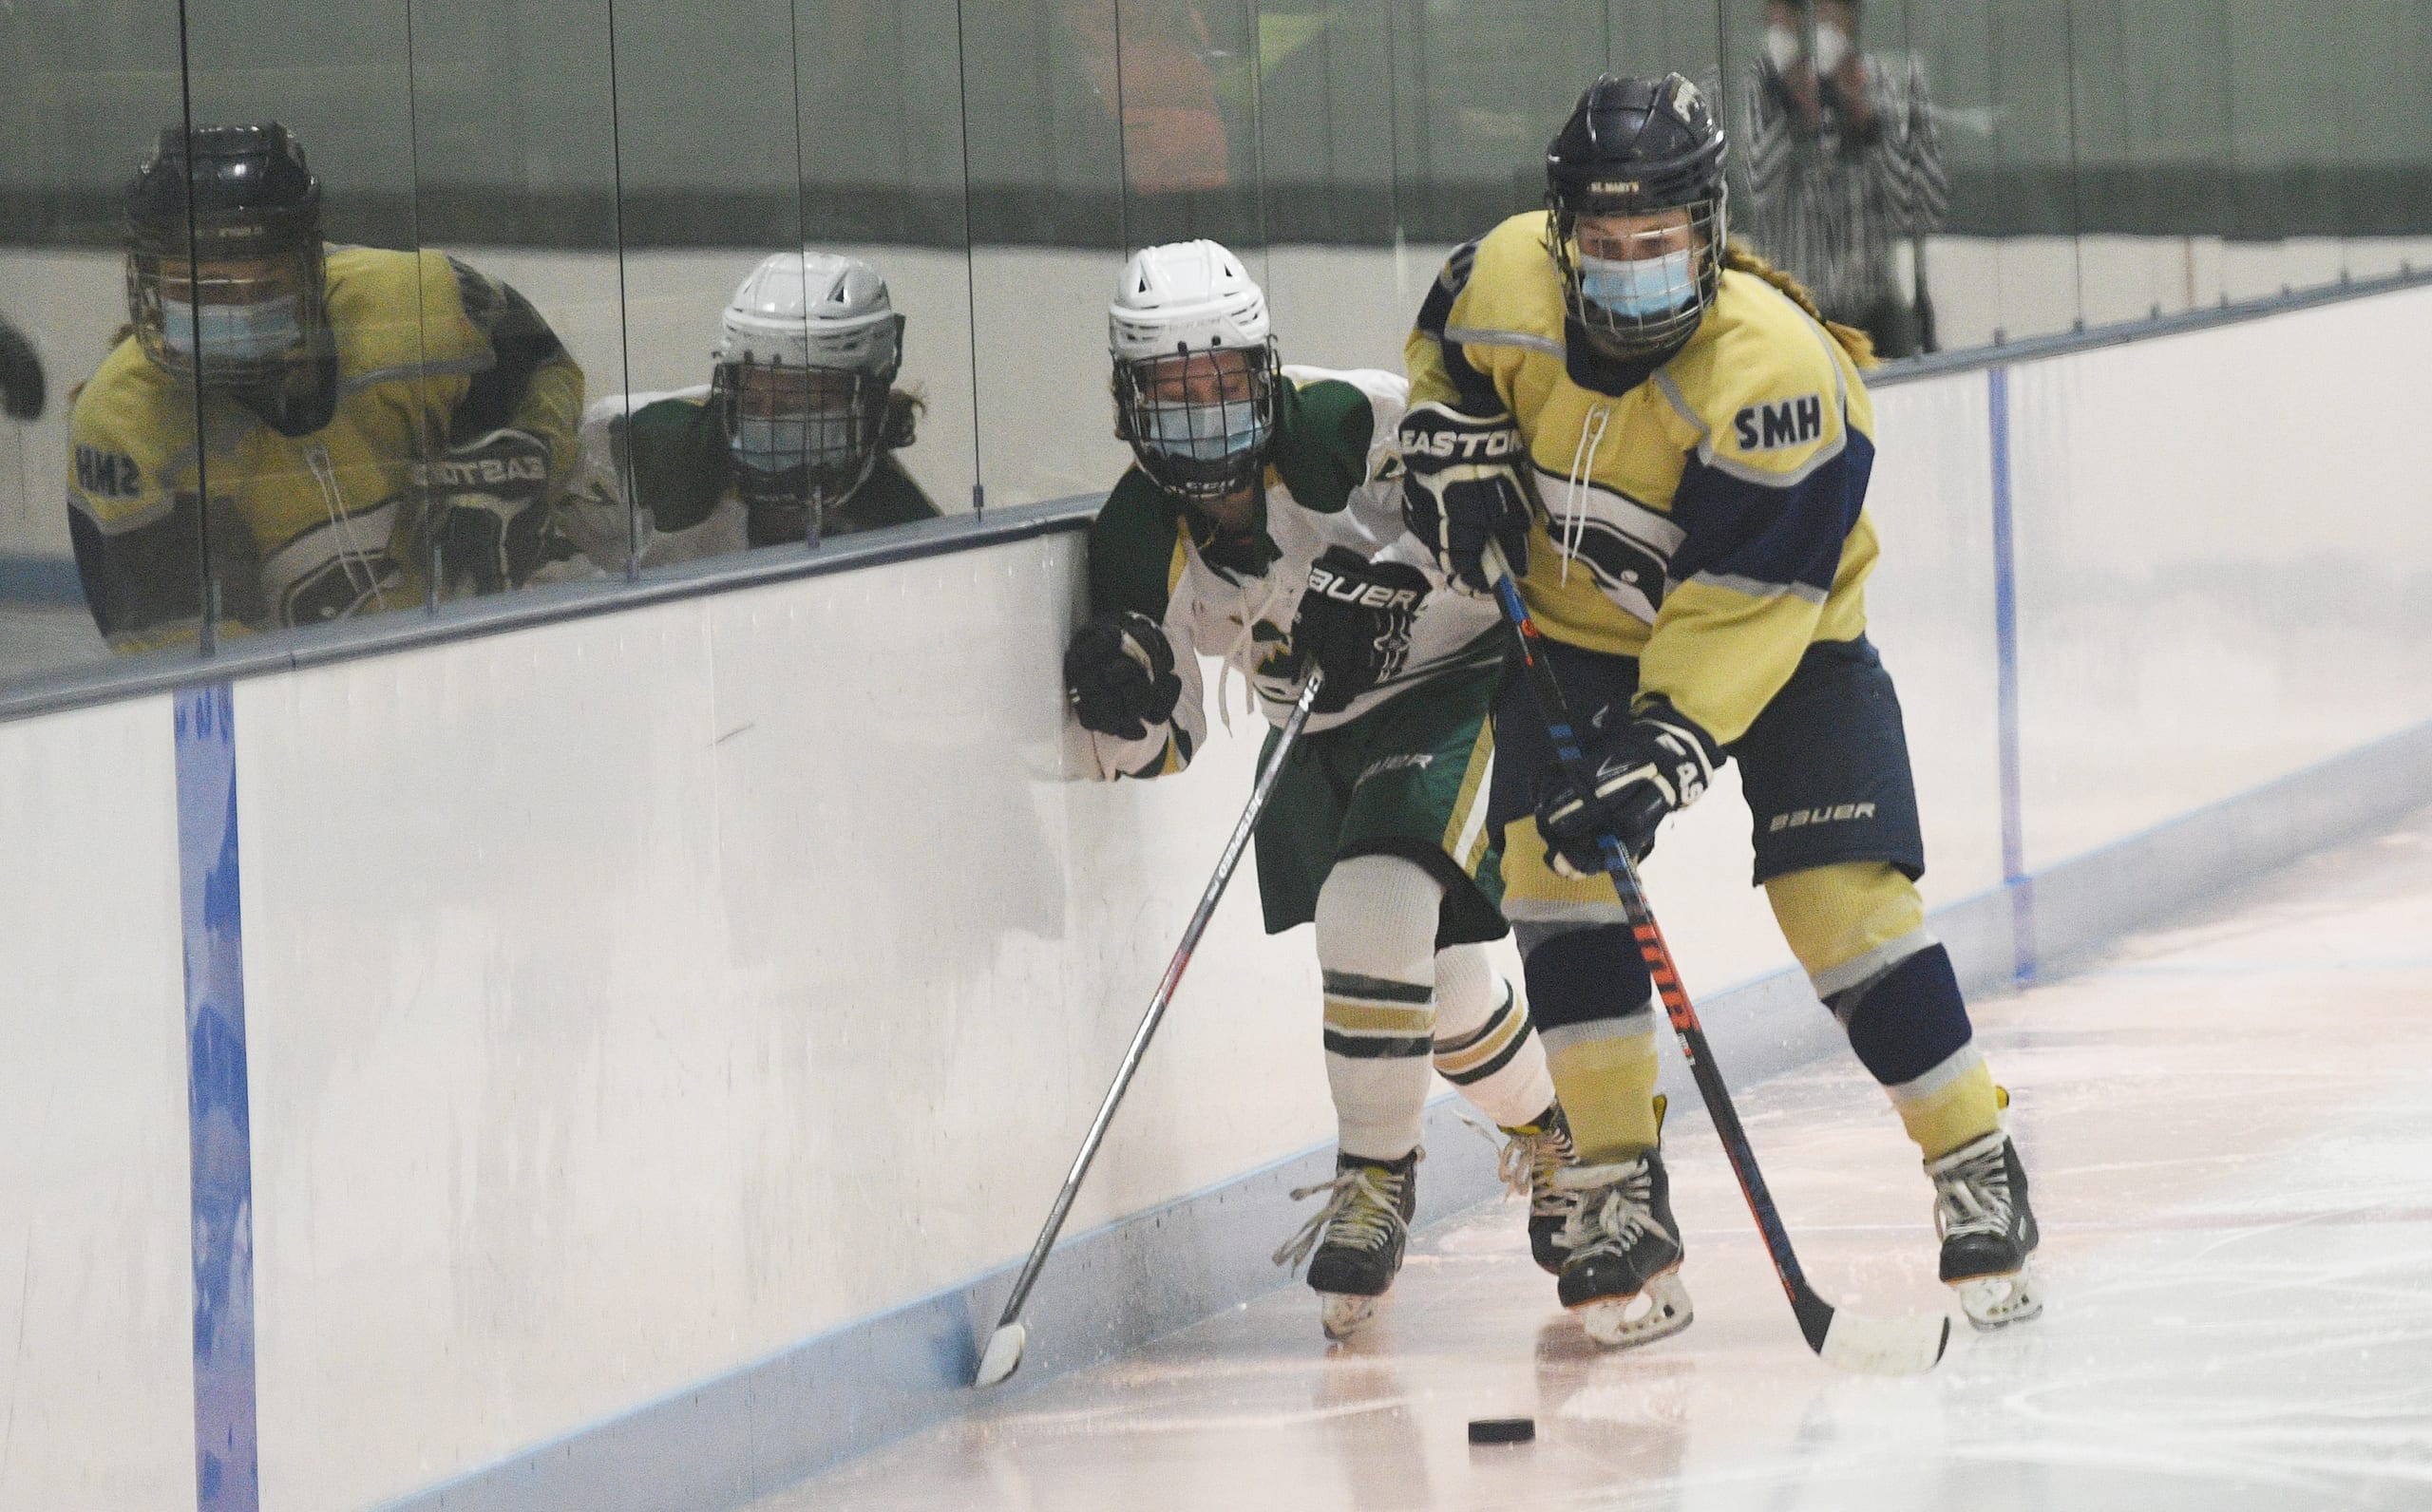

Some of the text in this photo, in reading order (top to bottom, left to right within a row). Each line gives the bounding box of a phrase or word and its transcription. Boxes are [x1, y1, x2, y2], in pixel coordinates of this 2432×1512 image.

[1734, 394, 1820, 449] SMH
[1308, 567, 1418, 612] AUER
[1770, 802, 1875, 832] BAUER
